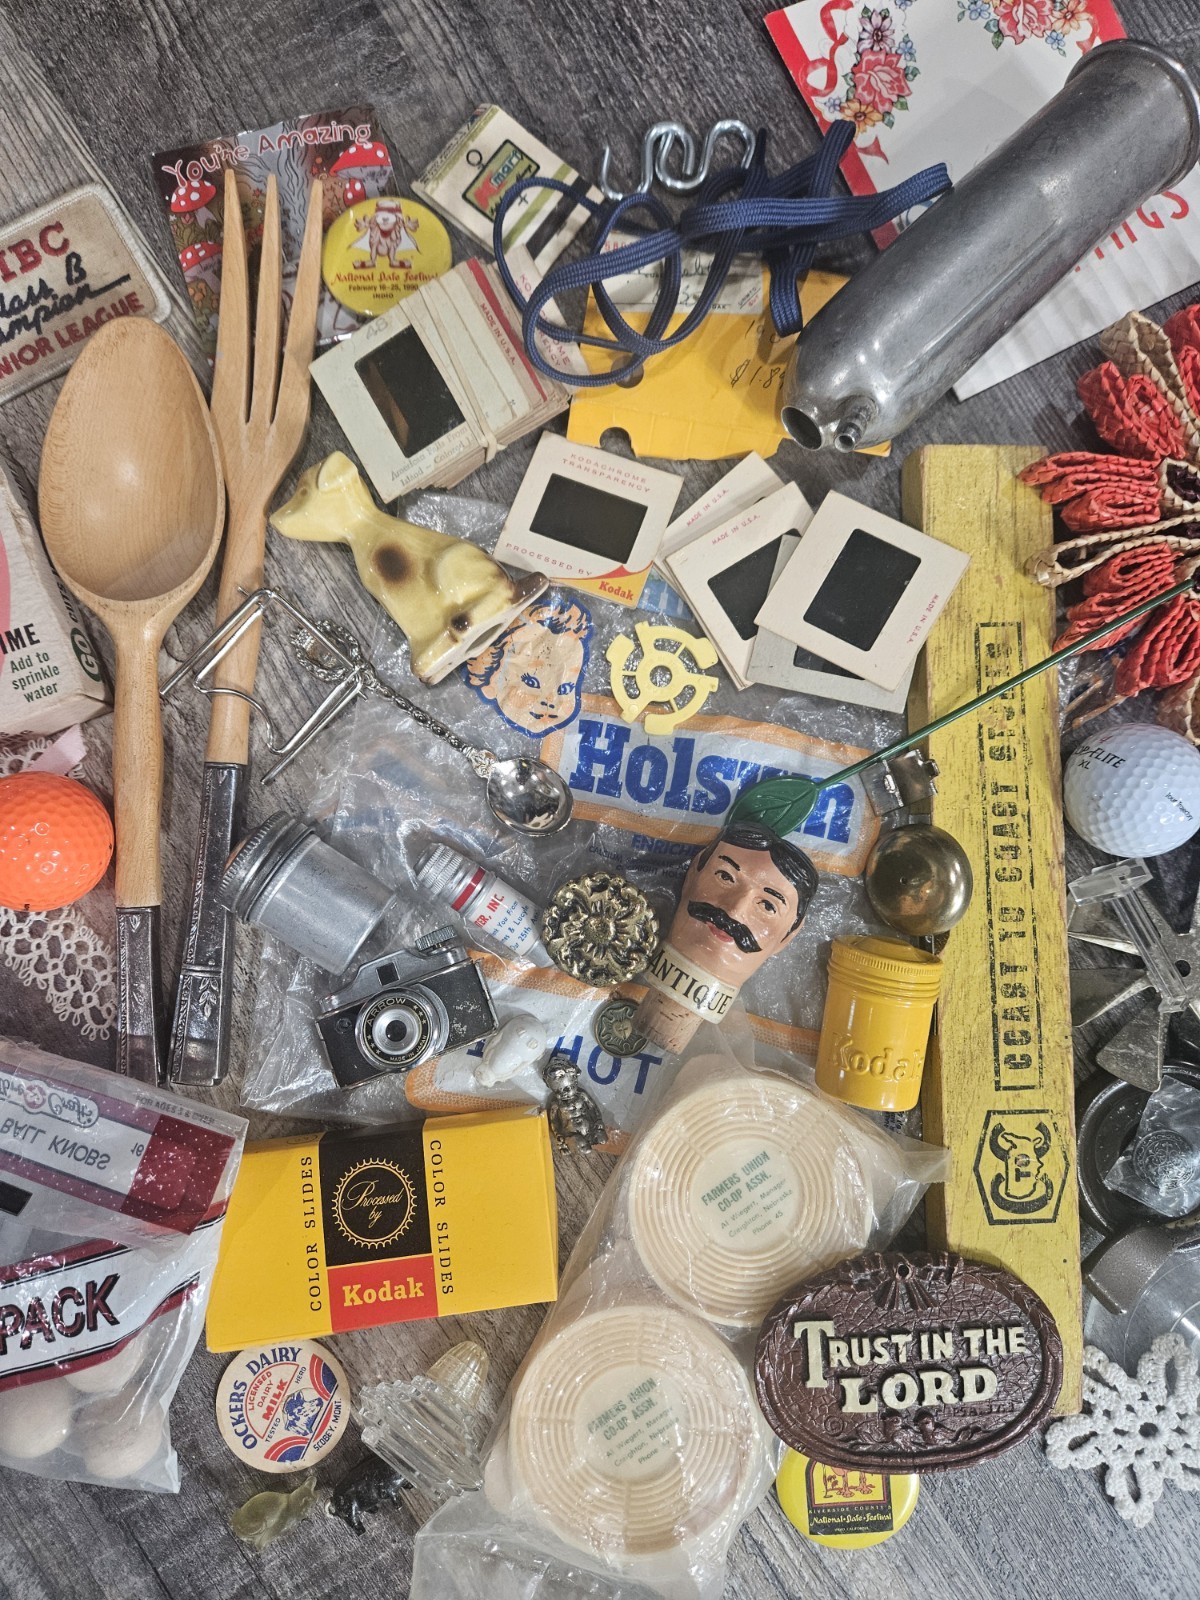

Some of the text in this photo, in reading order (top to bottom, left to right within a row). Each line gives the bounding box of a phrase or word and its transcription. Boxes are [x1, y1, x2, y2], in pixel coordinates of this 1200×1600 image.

[162, 144, 250, 188] You're
[257, 121, 372, 156] Amazing
[65, 252, 87, 286] B
[331, 272, 374, 286] National
[348, 284, 378, 292] February
[54, 291, 145, 350] LEAGUE
[481, 302, 497, 328] MADE
[561, 457, 652, 494] TRANSPARENCY
[569, 452, 648, 485] KODACHROME
[686, 511, 702, 527] MADE
[711, 531, 729, 545] MADE
[504, 542, 593, 577] PROCESSED BY
[598, 580, 635, 602] Kodak
[926, 593, 940, 613] MADE
[10, 652, 50, 673] Add to
[79, 637, 100, 677] GO
[12, 665, 60, 690] sprinkle
[23, 682, 58, 703] water
[1078, 759, 1091, 770] XL
[486, 893, 505, 913] INC.
[497, 916, 509, 929] You
[517, 924, 533, 943] 25th
[646, 948, 733, 1015] ANTIQUE
[365, 996, 407, 1027] ARROW
[1000, 961, 1032, 1071] COAST
[389, 1054, 406, 1062] MADE
[415, 1034, 428, 1053] JAPAN
[155, 1098, 177, 1113] AGES
[700, 1150, 771, 1207] FARMERS UNION
[717, 1170, 772, 1213] CO-OP ASSN.
[759, 1178, 787, 1201] Manager
[340, 1178, 405, 1211] Processed
[762, 1188, 794, 1213] Nebraska
[367, 1205, 383, 1229] by
[429, 1139, 454, 1296] COLOR SLIDES
[752, 1219, 774, 1236] Phone
[300, 1155, 322, 1312] COLOR SLIDES
[341, 1276, 425, 1308] Kodak
[0, 1273, 121, 1355] PACK
[919, 1331, 953, 1361] IN
[962, 1326, 1027, 1358] THE
[228, 1346, 303, 1450] OCKERS DAIRY
[248, 1370, 273, 1411] LICENSED
[256, 1379, 275, 1408] DAIRY
[261, 1378, 289, 1421] MILK
[838, 1366, 999, 1414] LORD
[332, 1397, 342, 1426] MONT.
[602, 1397, 659, 1441] CO-OP ASSN.
[264, 1417, 281, 1443] TESTED
[637, 1447, 660, 1465] Phone
[808, 1506, 851, 1515] RIVERSIDE
